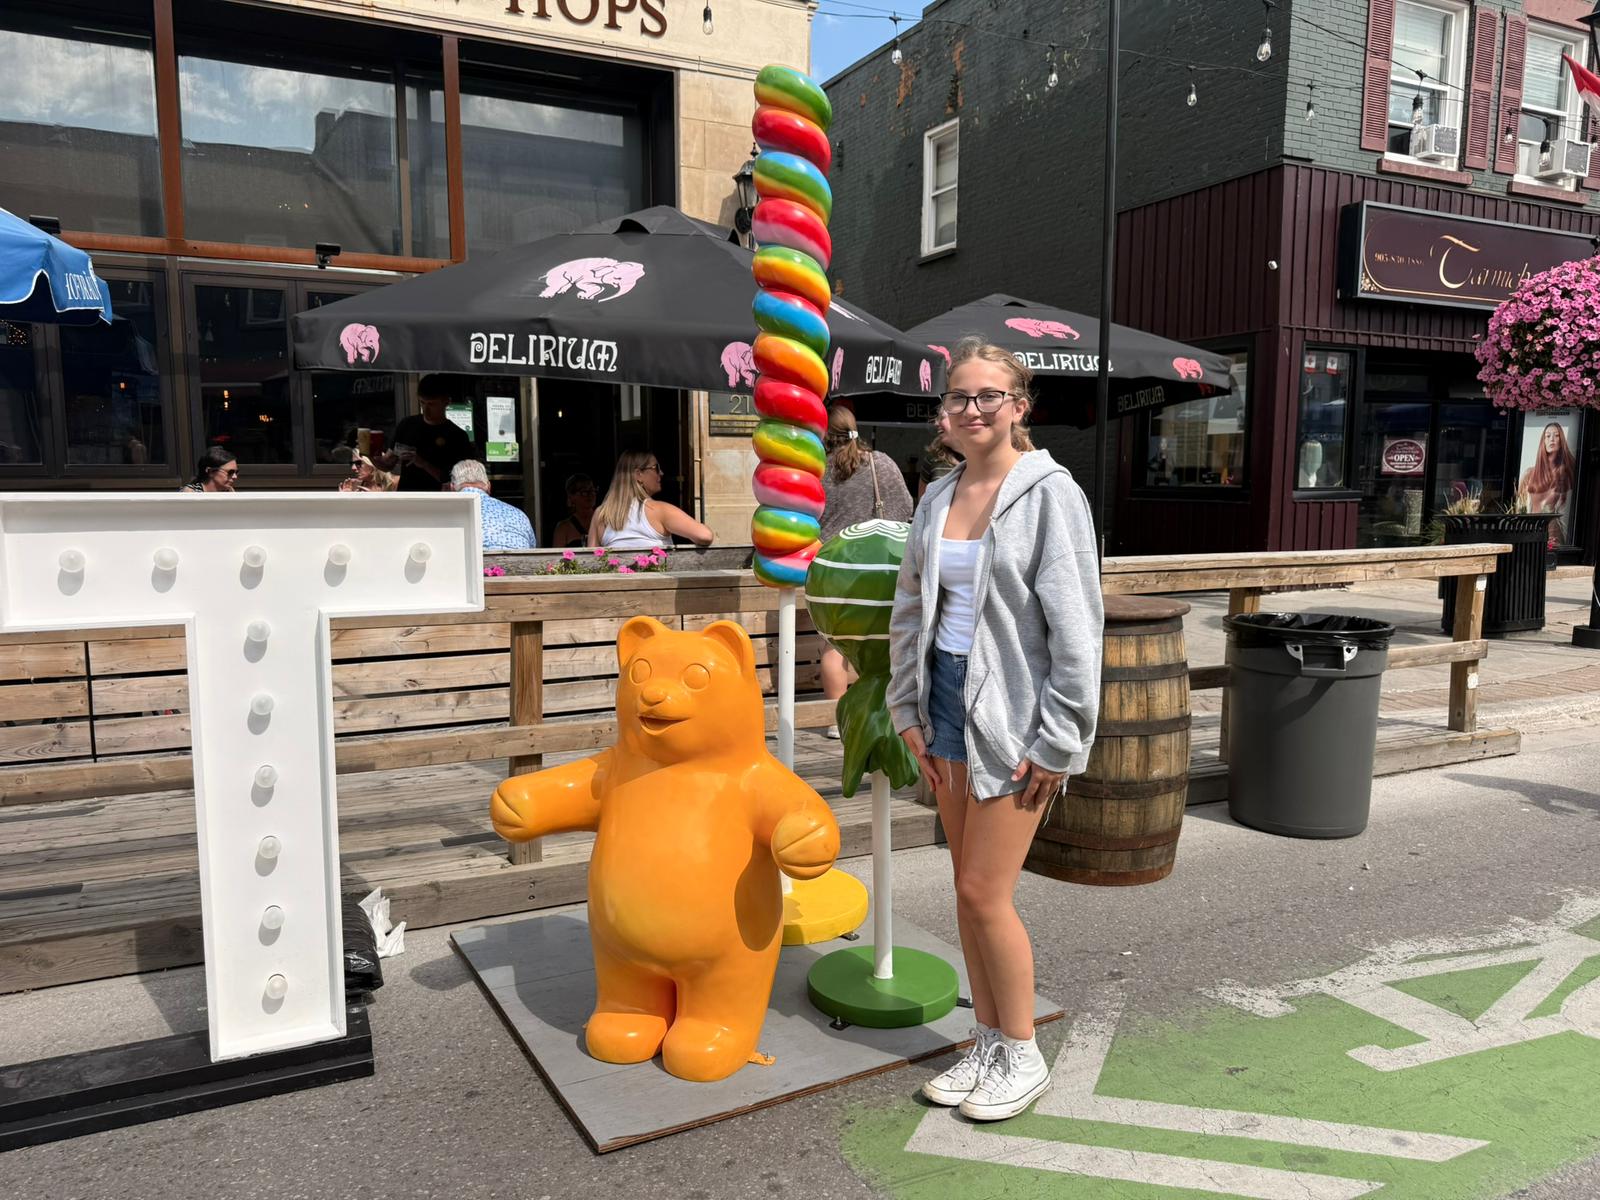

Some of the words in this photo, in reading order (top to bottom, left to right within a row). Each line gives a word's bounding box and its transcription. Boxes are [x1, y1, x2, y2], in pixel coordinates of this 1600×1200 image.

[470, 332, 618, 372] DELIRIUM
[1117, 385, 1166, 412] DELIRIUM
[1393, 453, 1416, 462] OPEN
